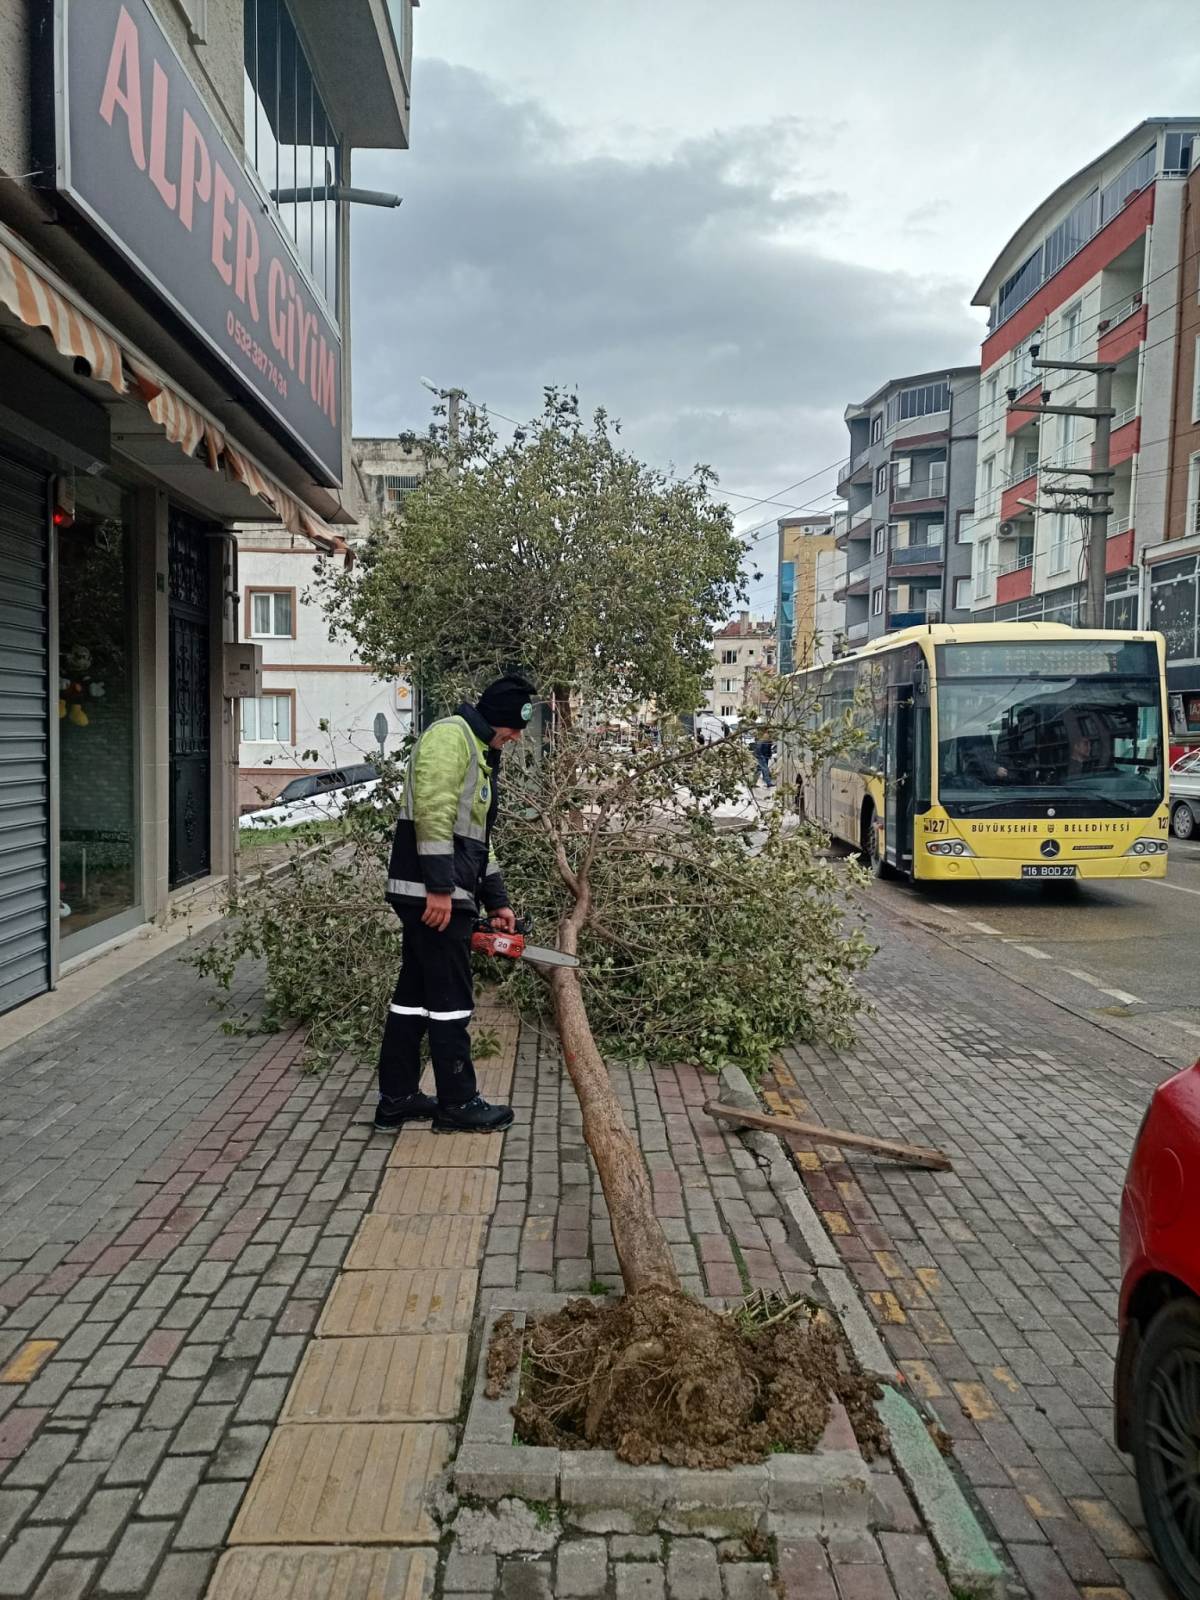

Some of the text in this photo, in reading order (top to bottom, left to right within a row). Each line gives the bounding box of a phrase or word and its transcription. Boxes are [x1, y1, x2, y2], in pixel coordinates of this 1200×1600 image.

[99, 4, 260, 322] ALPER
[971, 821, 1130, 834] BÜYÜKŞEHİR BELEDİYESİ
[1028, 866, 1037, 876] 16
[1063, 866, 1075, 876] 27
